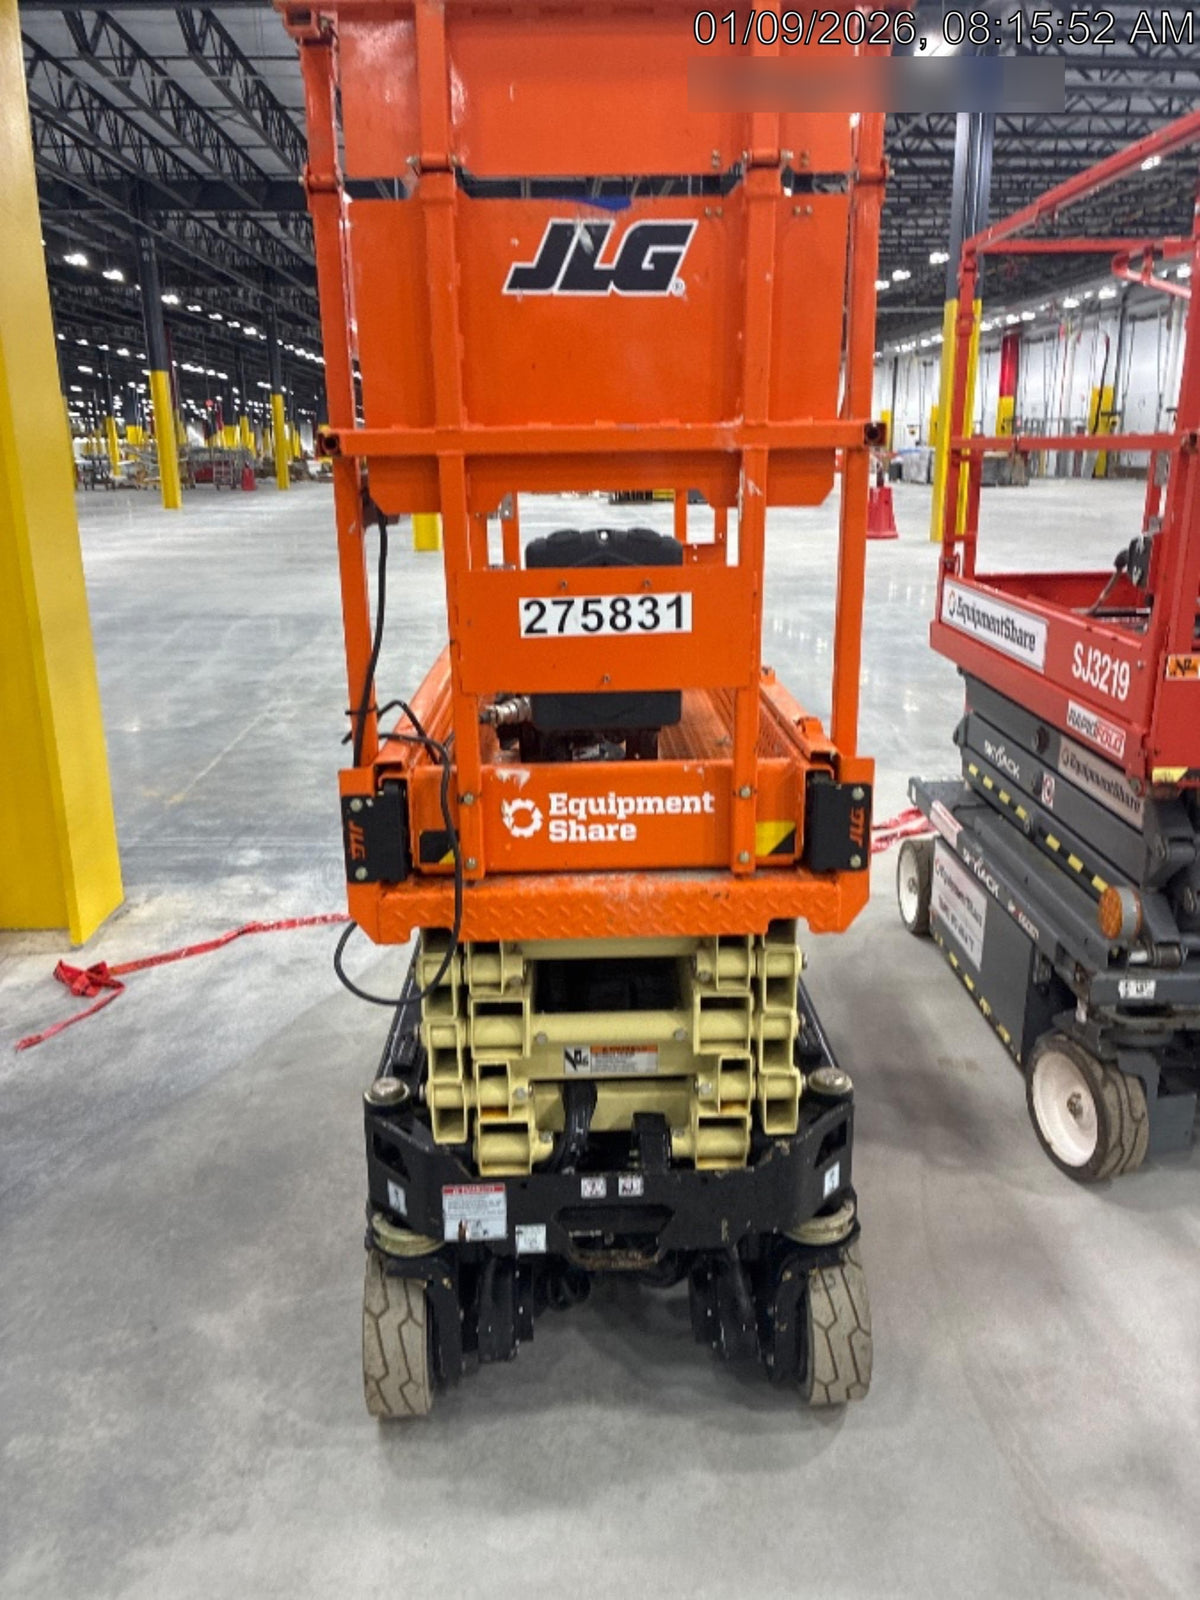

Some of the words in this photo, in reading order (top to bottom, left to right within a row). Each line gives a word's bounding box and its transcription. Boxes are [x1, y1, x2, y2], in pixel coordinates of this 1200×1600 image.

[502, 217, 699, 297] JLG
[523, 593, 684, 635] 275831
[957, 594, 1037, 652] EquipmentShare
[1071, 641, 1131, 702] SJ3219
[548, 790, 716, 821] Equipment
[348, 820, 366, 861] JLG
[548, 818, 637, 843] Share
[849, 806, 865, 849] JLG
